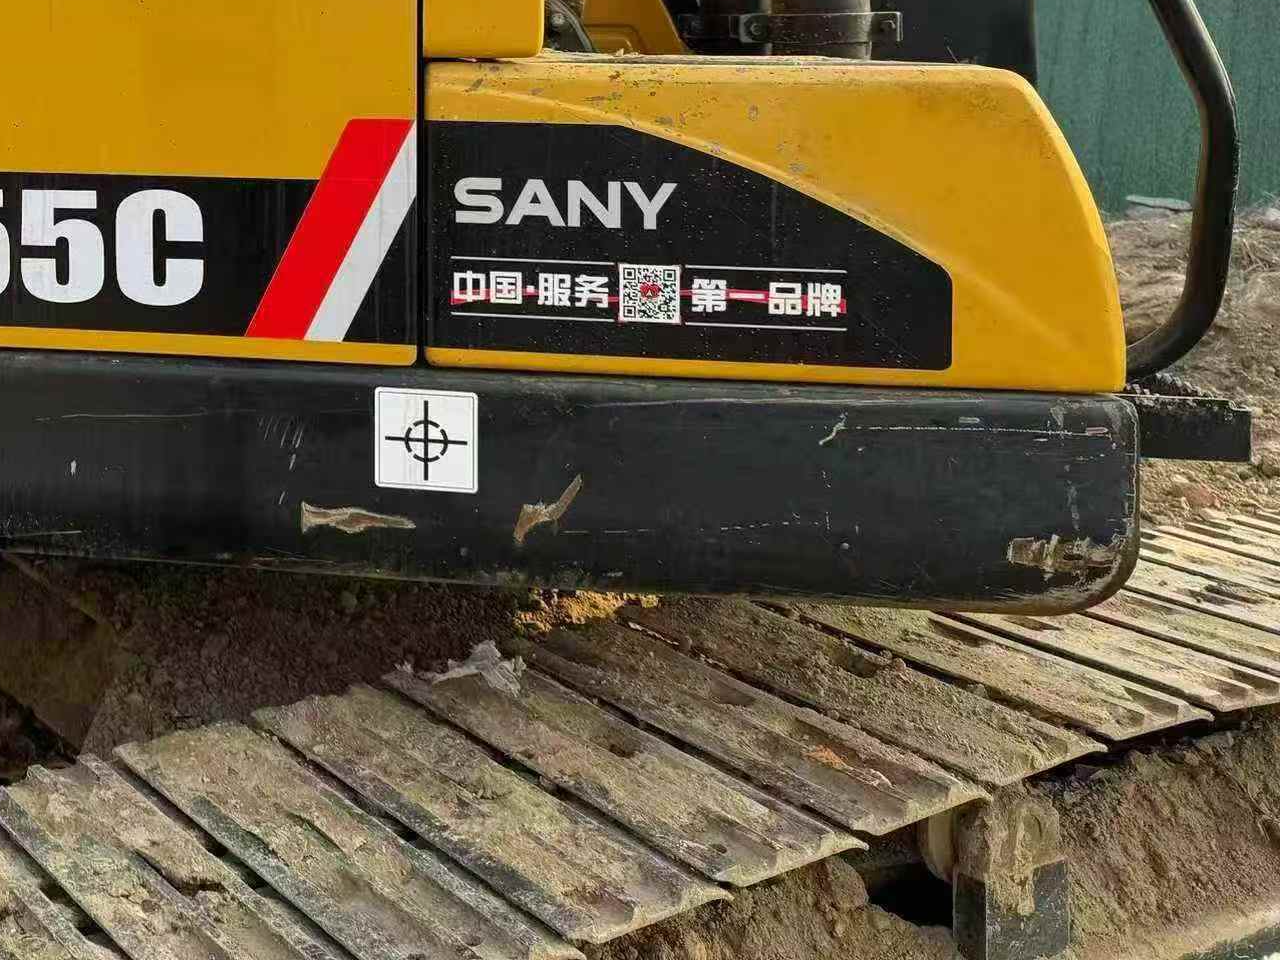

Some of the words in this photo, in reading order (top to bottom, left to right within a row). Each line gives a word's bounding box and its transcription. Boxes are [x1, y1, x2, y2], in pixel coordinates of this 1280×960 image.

[453, 177, 678, 230] SANY
[690, 278, 843, 319] 第一品牌
